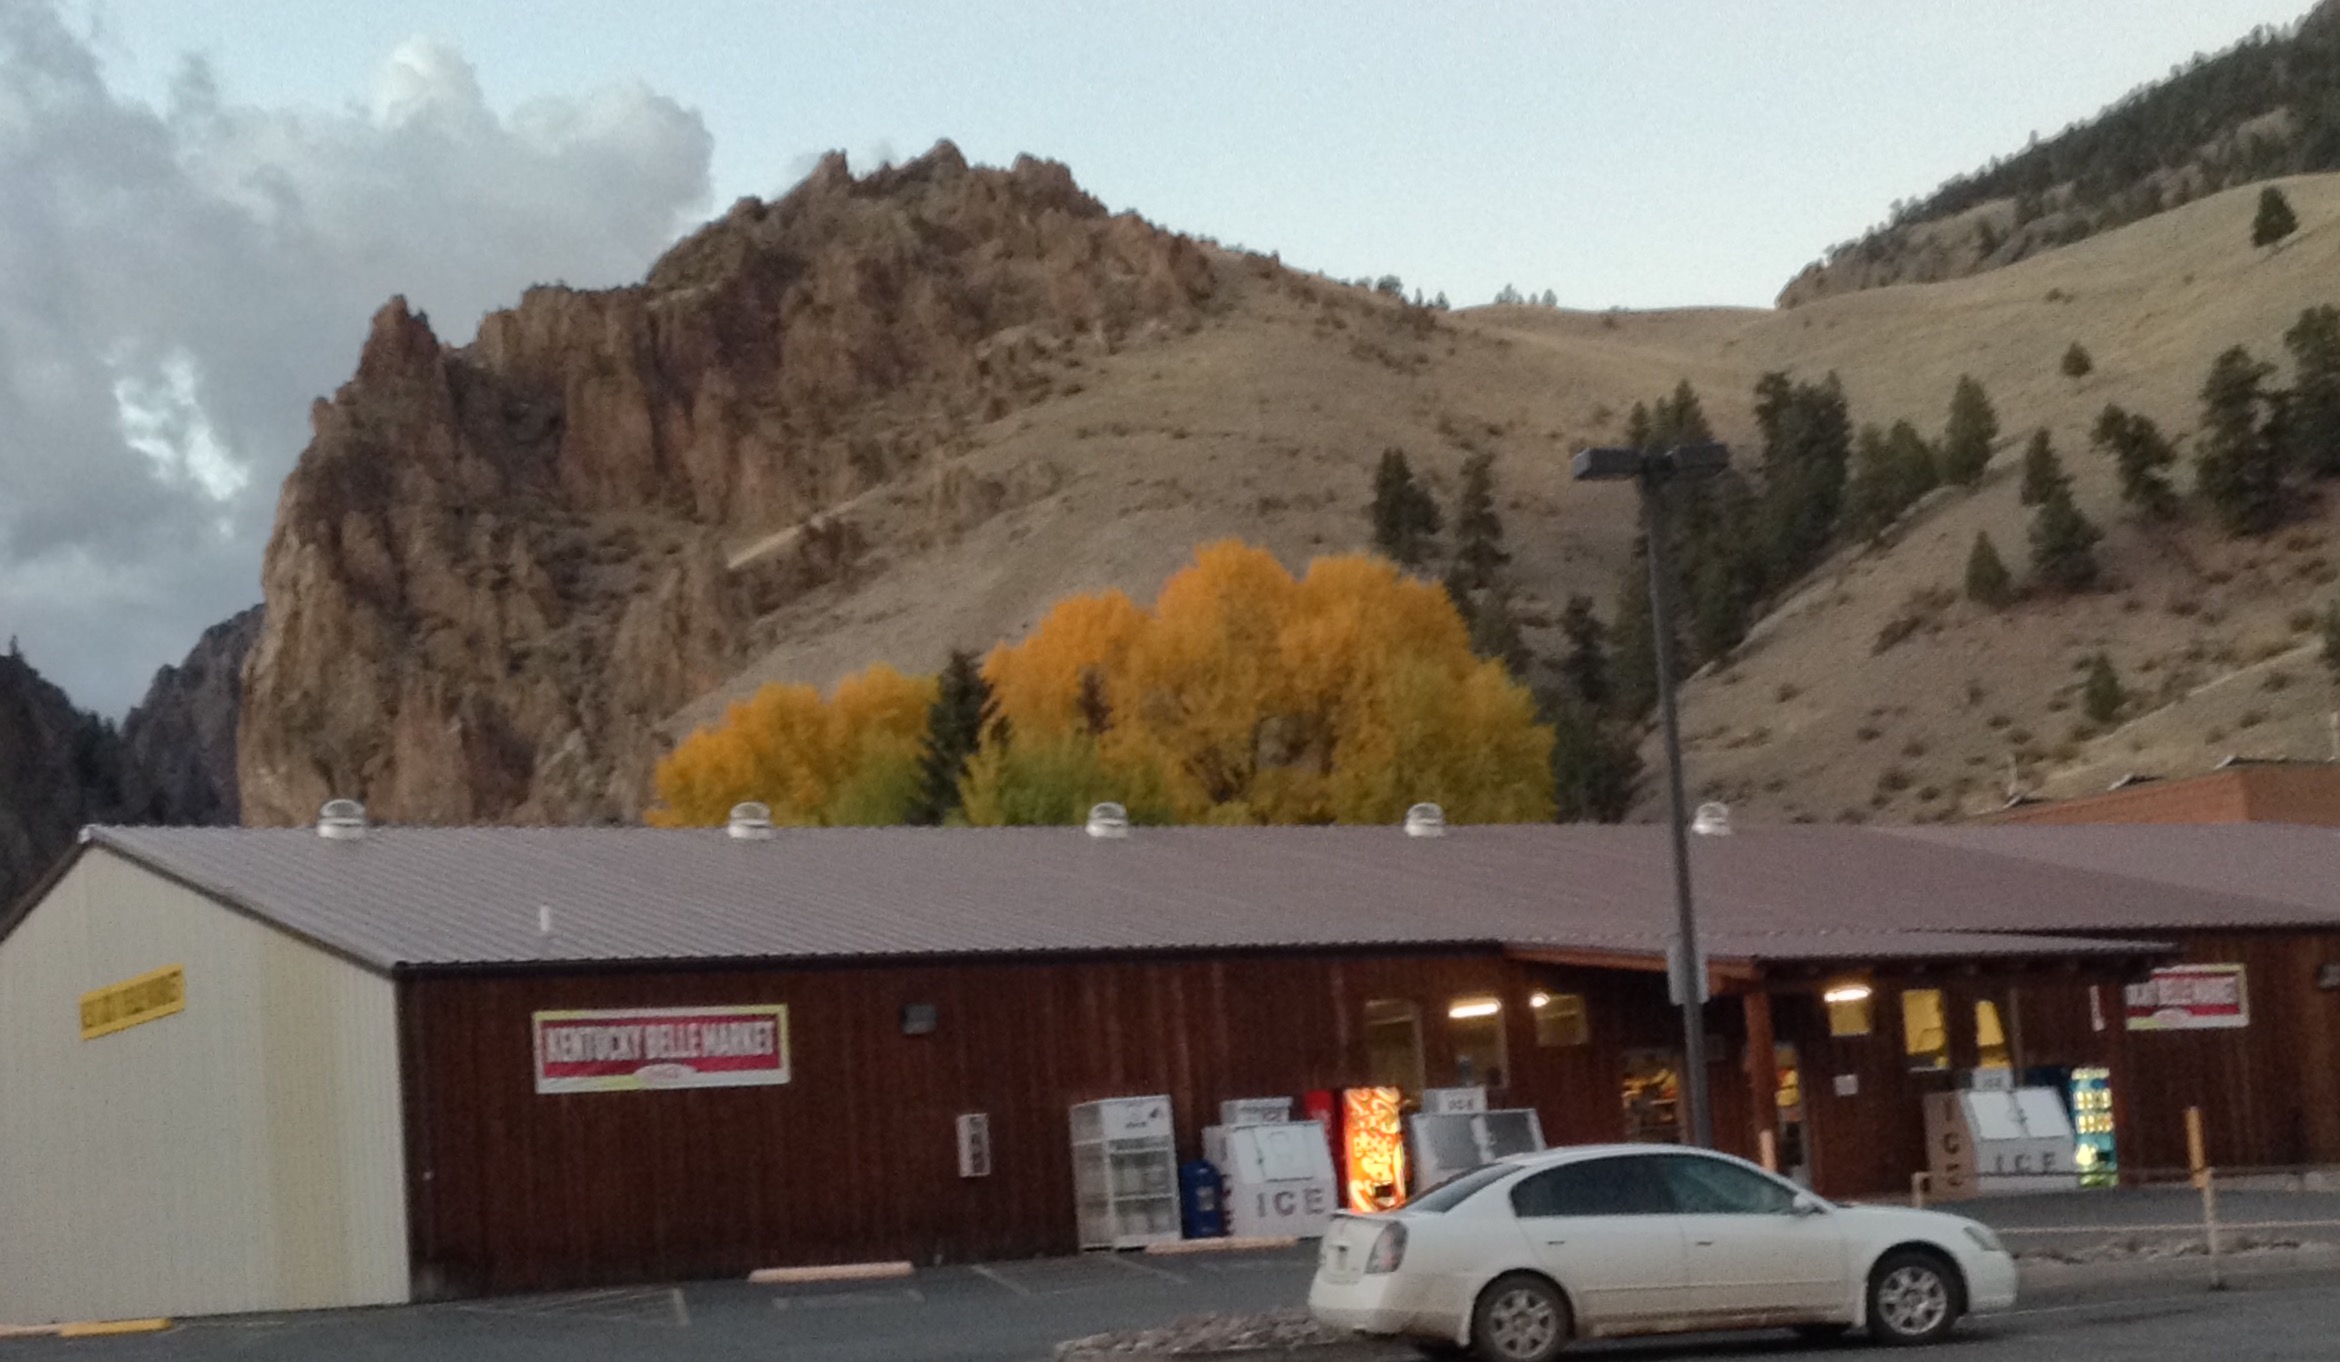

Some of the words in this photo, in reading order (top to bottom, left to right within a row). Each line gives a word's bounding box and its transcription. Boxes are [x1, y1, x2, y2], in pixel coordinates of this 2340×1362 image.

[546, 1026, 641, 1062] KENTUCKY
[645, 1023, 701, 1058] BELLE
[703, 1020, 774, 1056] MARKET
[1995, 1152, 2056, 1172] ICE
[1257, 1188, 1325, 1218] ICE
